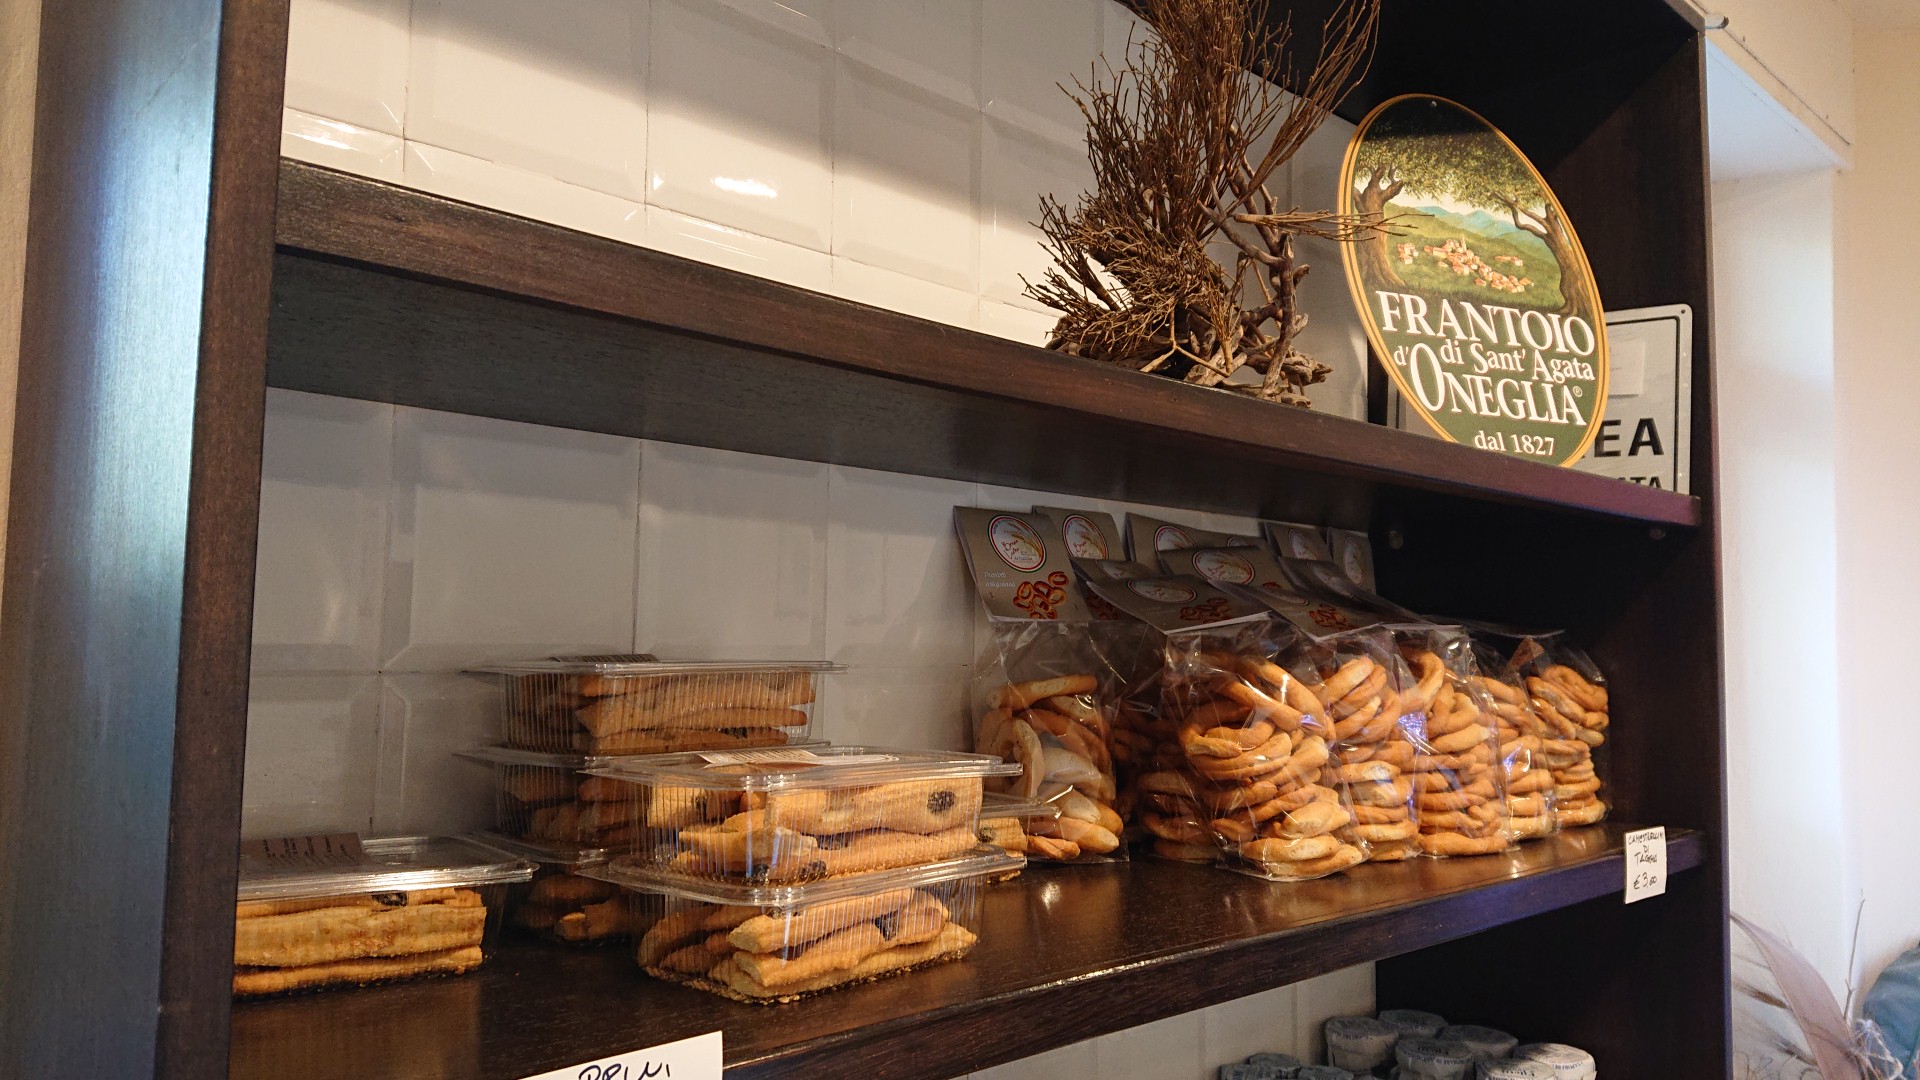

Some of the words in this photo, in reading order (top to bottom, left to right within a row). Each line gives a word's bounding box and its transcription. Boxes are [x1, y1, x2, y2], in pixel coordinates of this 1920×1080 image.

[1375, 290, 1595, 357] FRANTOIO
[1440, 339, 1464, 364] di
[1474, 430, 1506, 451] dal
[1510, 434, 1555, 456] 1827
[1580, 417, 1665, 459] EA
